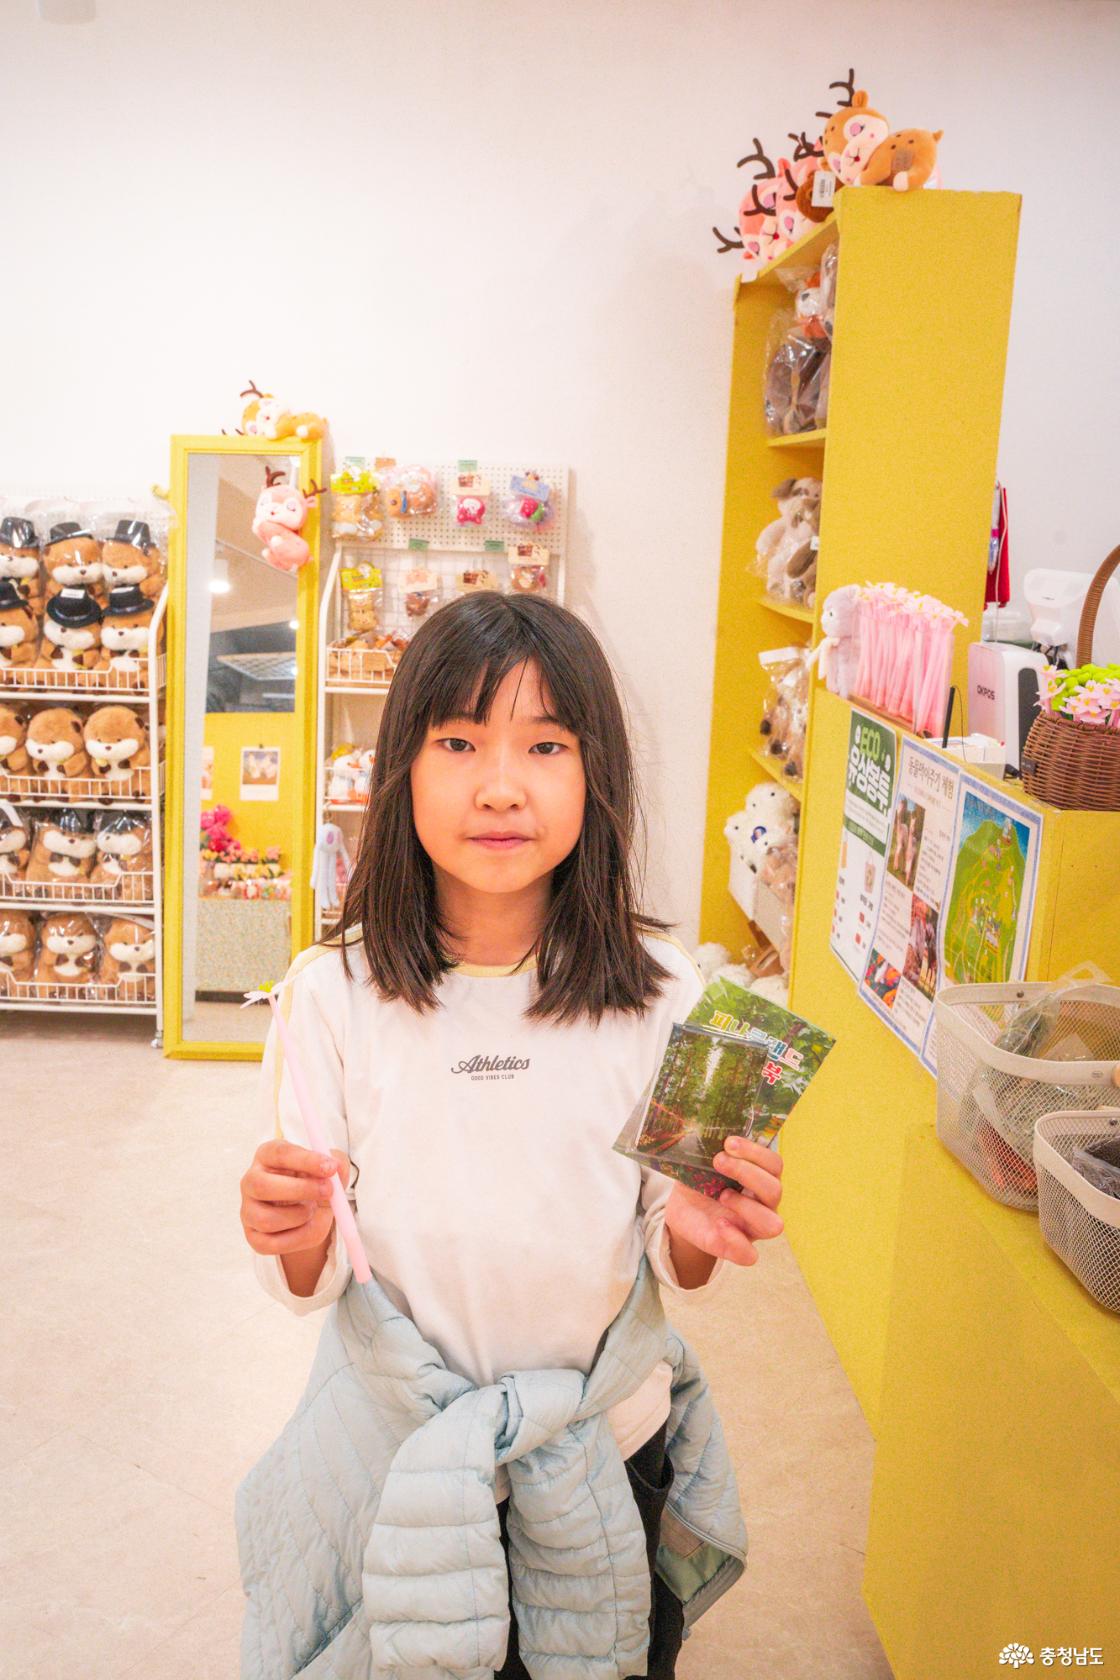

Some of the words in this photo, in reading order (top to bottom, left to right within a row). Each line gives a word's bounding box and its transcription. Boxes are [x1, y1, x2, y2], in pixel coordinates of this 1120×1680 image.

[976, 684, 996, 701] OKPOS
[860, 726, 881, 761] ECO
[450, 1054, 531, 1074] Athletics
[762, 1061, 783, 1085] 북
